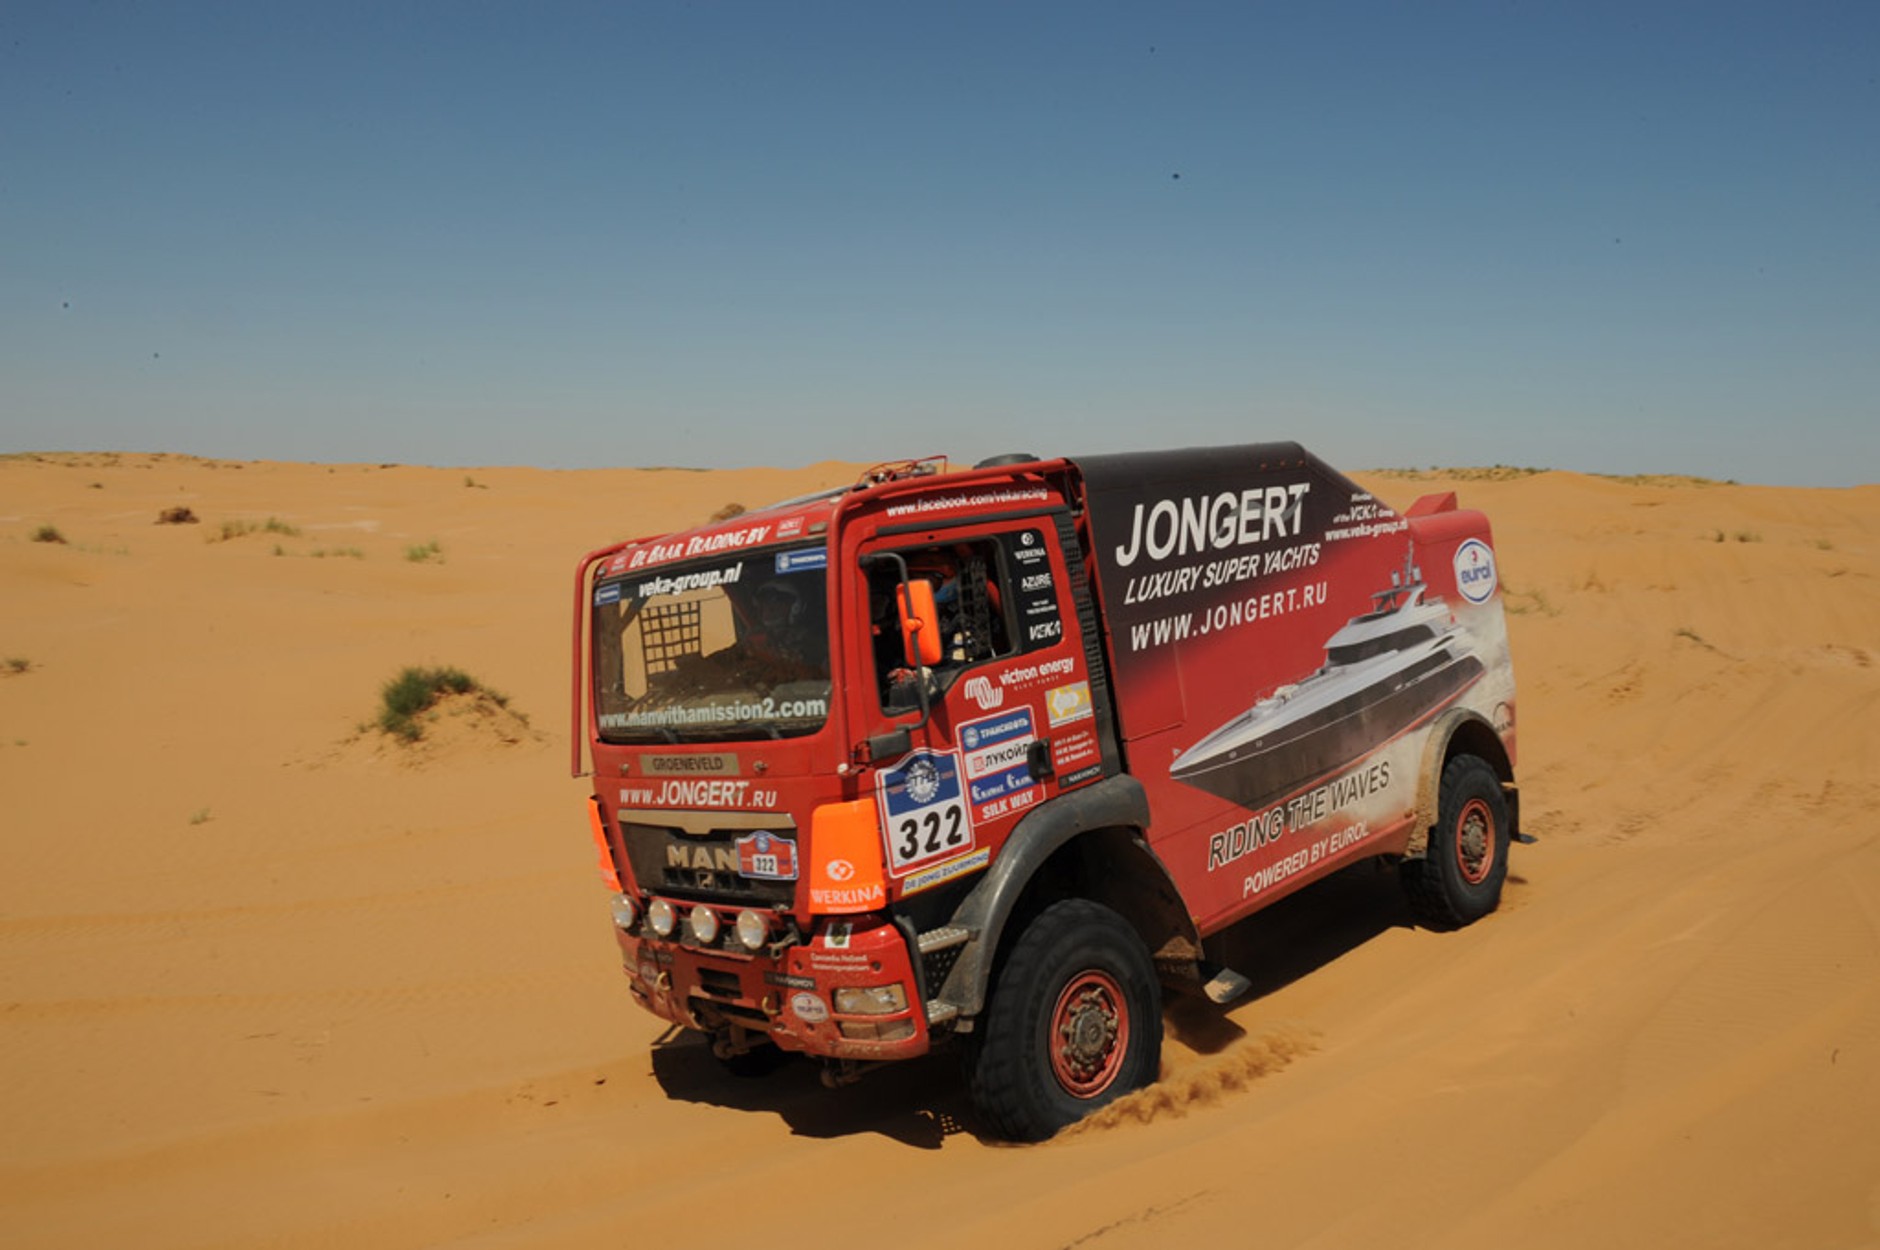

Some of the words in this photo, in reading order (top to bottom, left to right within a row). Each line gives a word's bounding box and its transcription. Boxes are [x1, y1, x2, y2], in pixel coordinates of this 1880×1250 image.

[887, 489, 1048, 517] www.facebook.com/vekaracing
[1115, 483, 1311, 567] JONGERT
[1324, 517, 1408, 541] www.veka-group.nl
[629, 549, 649, 569] DE
[646, 542, 683, 565] BAAR
[686, 530, 747, 556] TRADING
[746, 525, 771, 544] BV
[638, 561, 743, 597] veka-group.nl
[1124, 566, 1203, 605] LUXURY
[1202, 553, 1261, 589] SUPER
[1260, 541, 1321, 574] YACHTS
[1461, 560, 1492, 584] eurol
[1130, 581, 1329, 652] WWW.JONGERT.RU
[999, 664, 1038, 686] victron
[1039, 656, 1075, 675] energy
[599, 698, 826, 727] www.manwithamission2.com
[652, 756, 725, 771] GROENEVELD
[619, 780, 778, 807] www.JONGERT.RU
[982, 800, 1008, 820] SILK
[1010, 789, 1034, 809] WAY
[1207, 807, 1286, 872] RIDING
[1287, 787, 1328, 833] THE
[1331, 761, 1390, 811] WAVES
[899, 804, 962, 860] 322
[667, 845, 739, 872] MAN
[755, 856, 775, 872] 322
[1243, 851, 1310, 898] POWERED
[1310, 842, 1331, 867] BY
[1329, 820, 1370, 857] EUROL
[810, 884, 884, 905] WERKINA
